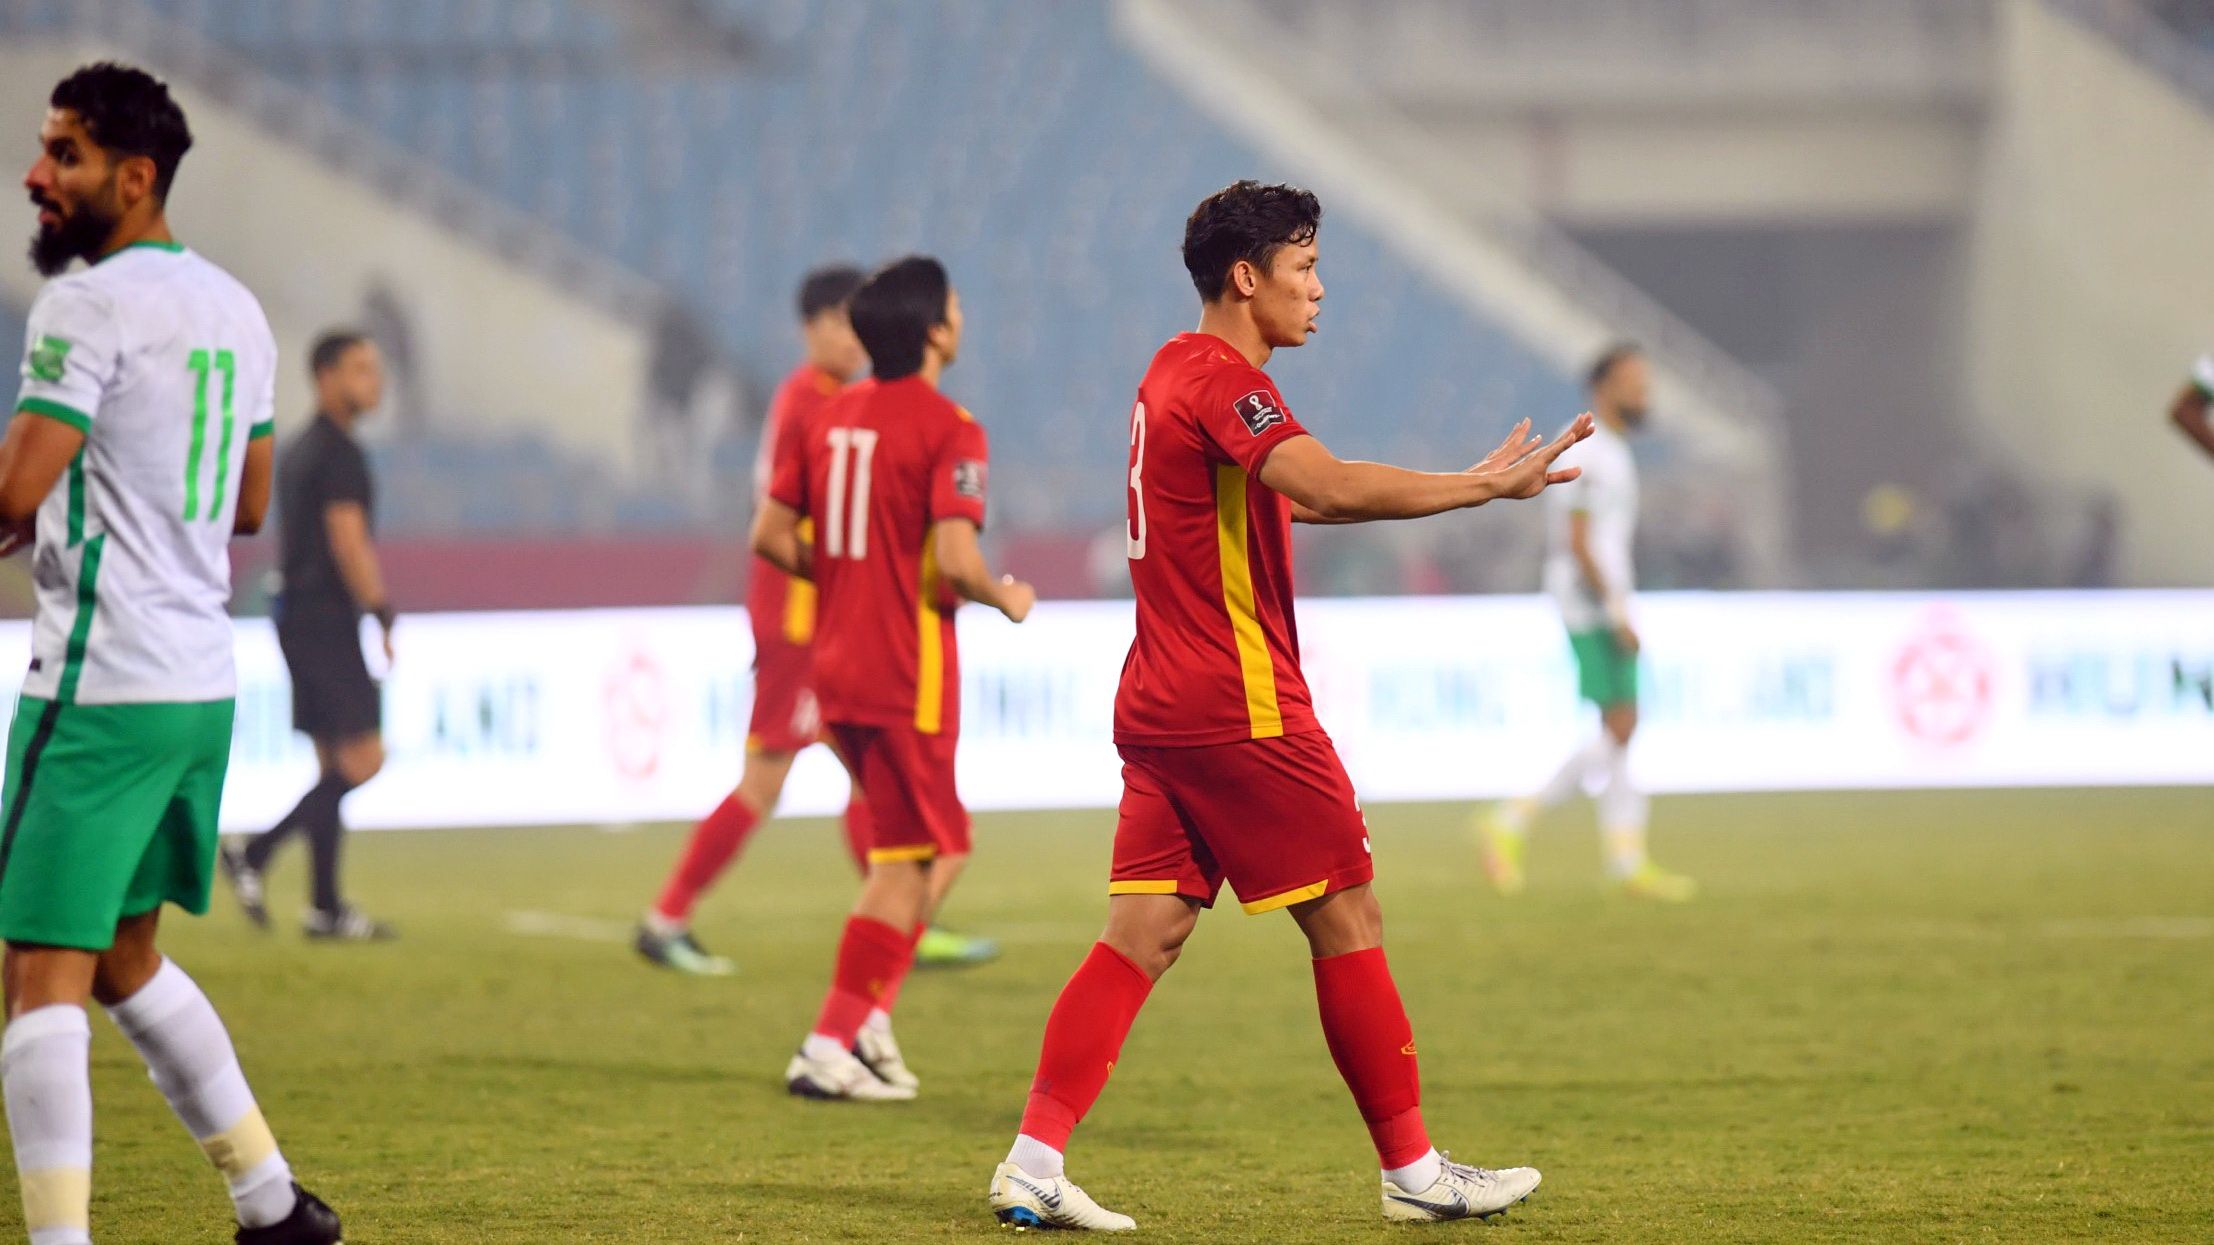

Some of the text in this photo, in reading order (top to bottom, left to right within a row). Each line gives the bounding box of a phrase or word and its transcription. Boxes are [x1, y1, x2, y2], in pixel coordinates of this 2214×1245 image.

[183, 349, 235, 522] 11
[826, 427, 879, 561] 11
[1127, 401, 1146, 560] 3
